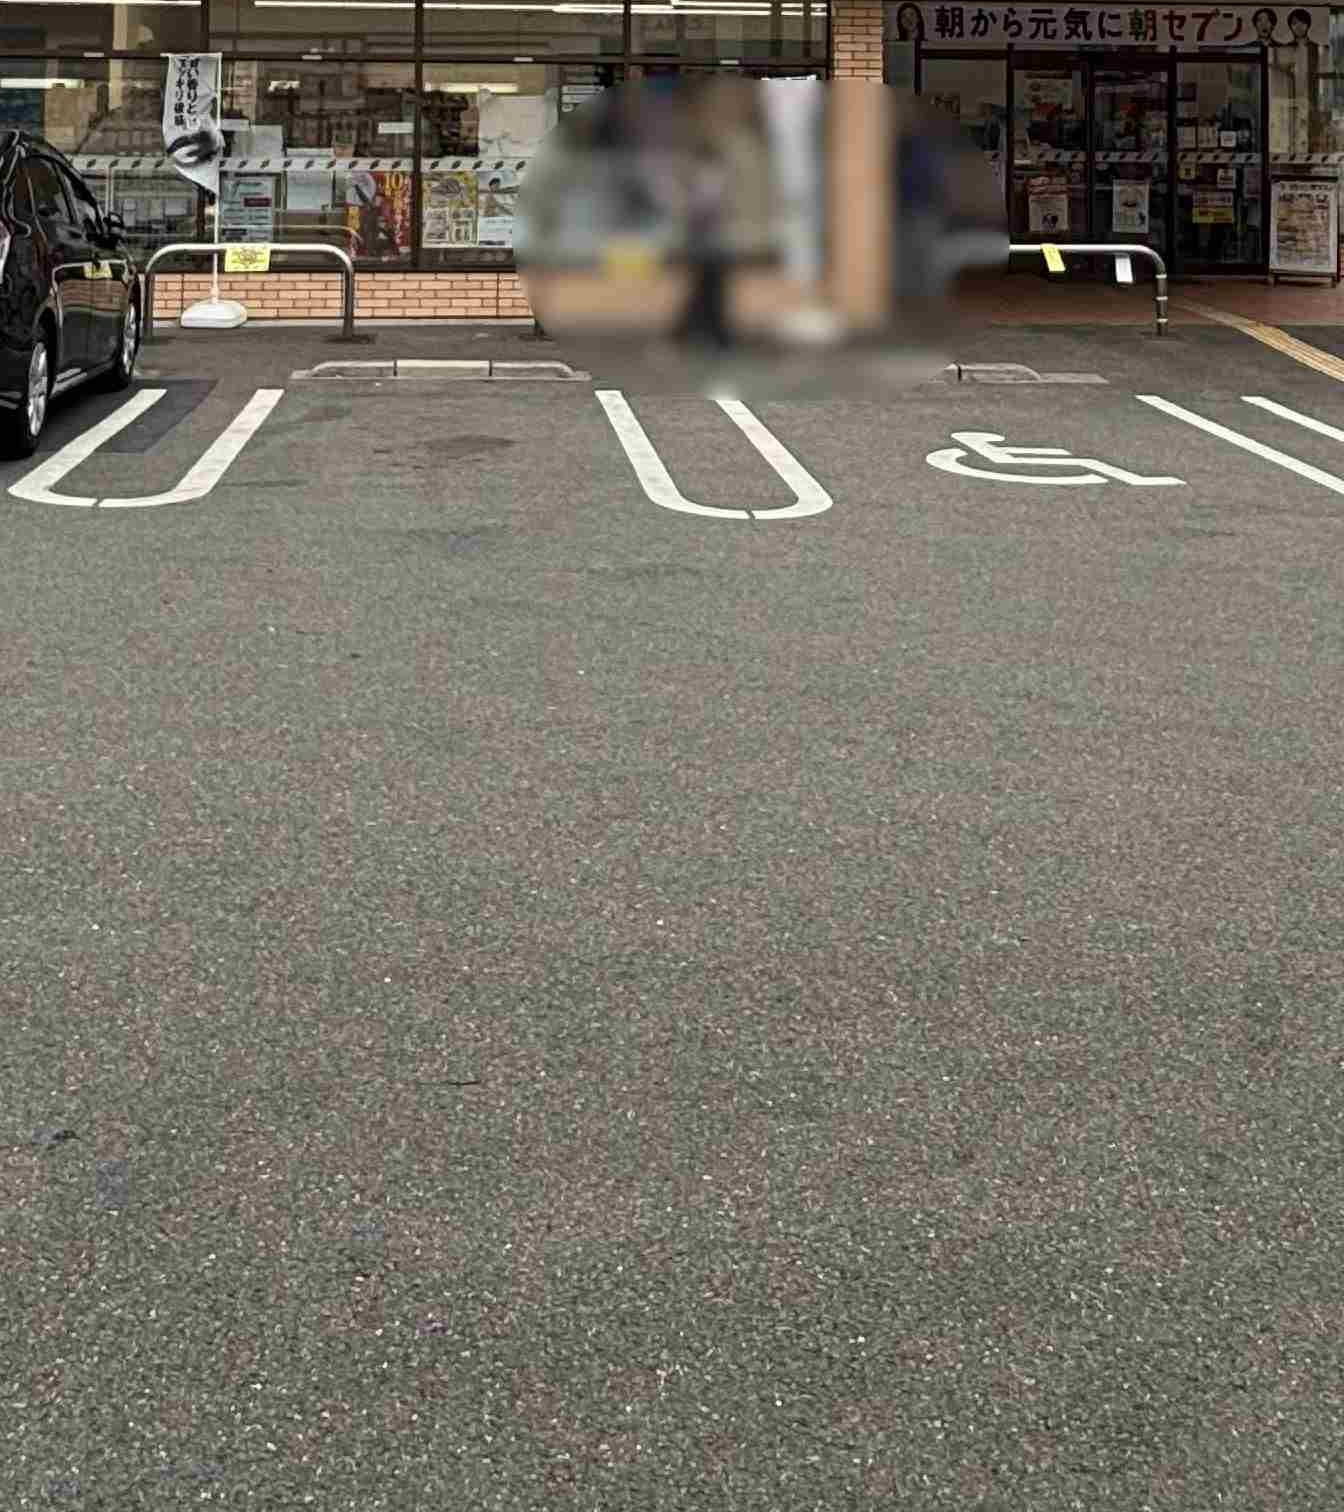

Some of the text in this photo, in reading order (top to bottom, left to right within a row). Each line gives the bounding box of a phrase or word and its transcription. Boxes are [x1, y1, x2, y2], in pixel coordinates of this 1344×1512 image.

[935, 6, 1243, 42] 朝から元気に朝セブン
